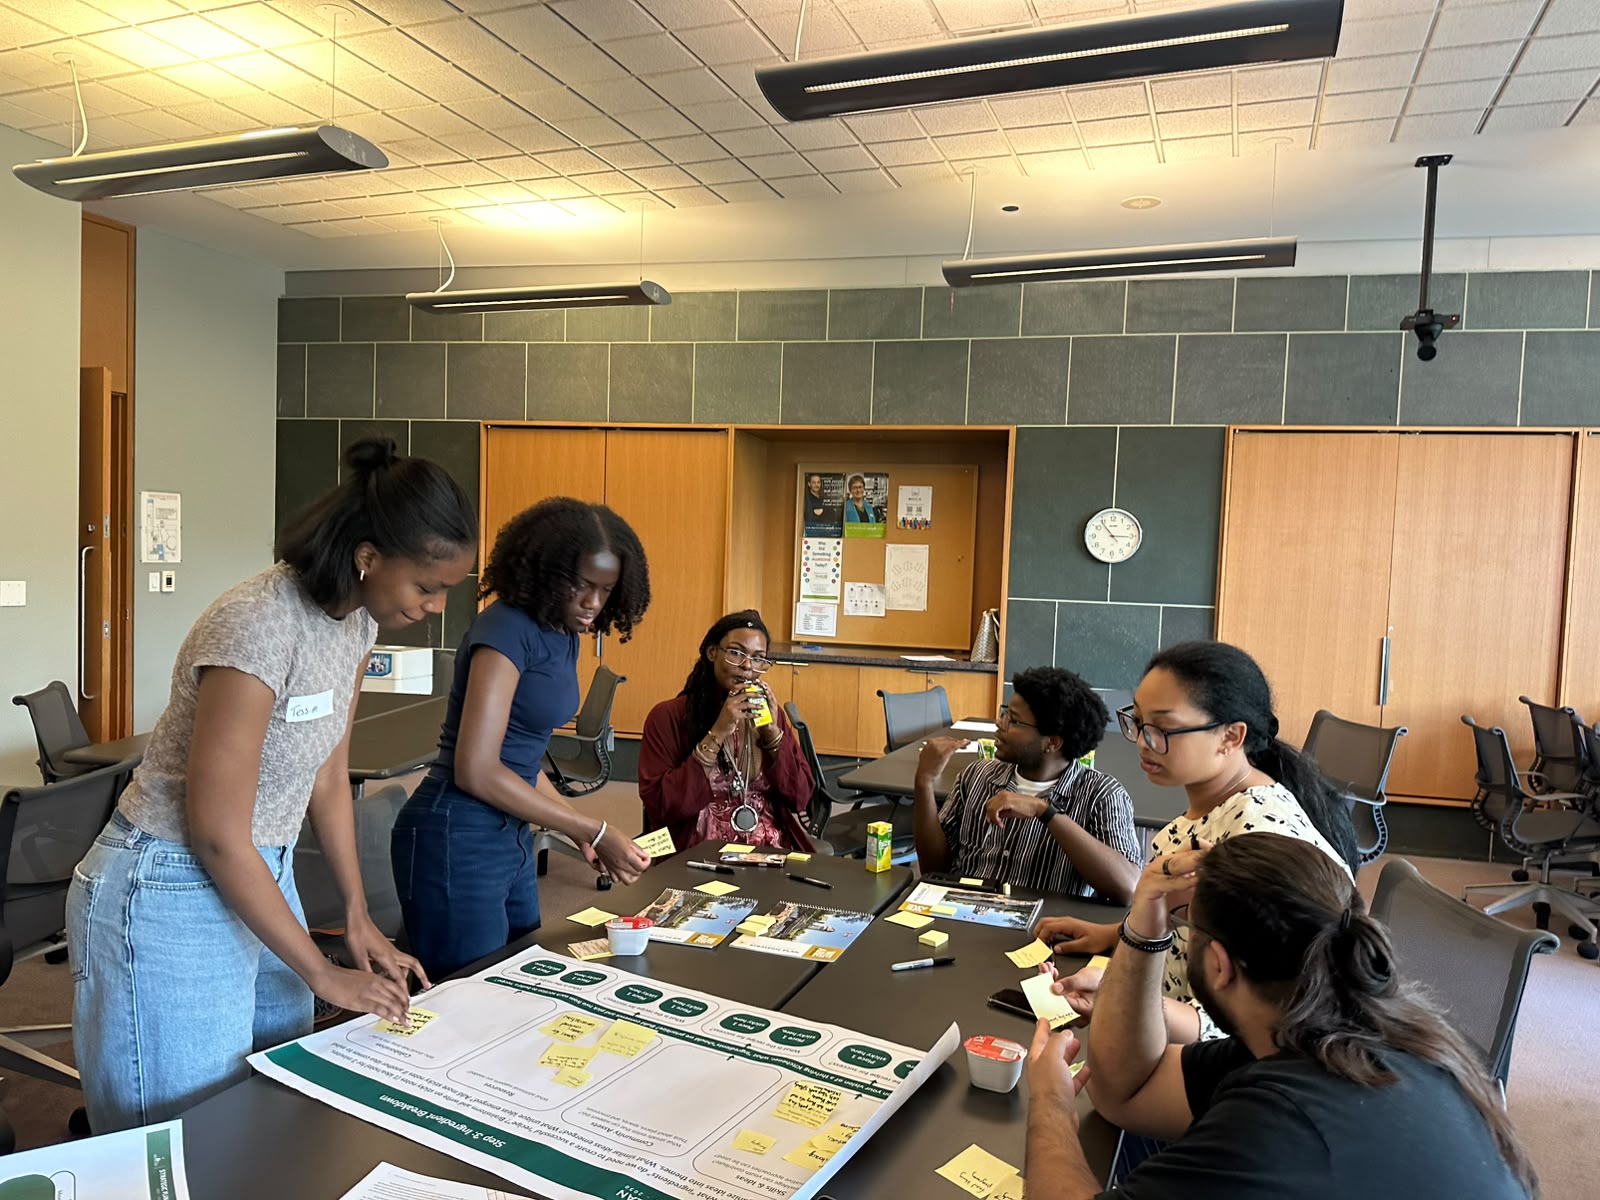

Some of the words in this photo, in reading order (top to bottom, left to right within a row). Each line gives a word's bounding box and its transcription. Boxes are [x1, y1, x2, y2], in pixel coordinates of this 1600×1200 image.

[750, 944, 781, 952] STRATEGIC
[640, 990, 658, 998] sticky
[568, 996, 581, 1004] from
[603, 996, 627, 1008] success?
[581, 1001, 593, 1010] two
[593, 1006, 604, 1015] pick
[635, 1005, 653, 1014] recipe
[685, 1002, 704, 1011] sticky
[668, 1016, 685, 1024] What
[732, 1016, 748, 1024] here.
[747, 1019, 766, 1028] sticky
[640, 1021, 656, 1030] Build
[655, 1025, 686, 1037] prioritize?
[709, 1027, 736, 1038] success?
[781, 1028, 797, 1037] here.
[797, 1031, 816, 1040] sticky
[695, 1036, 715, 1047] should
[746, 1037, 765, 1047] recipe
[376, 1043, 411, 1058] Collaboration
[850, 1047, 867, 1057] here.
[858, 1056, 876, 1065] Place
[867, 1051, 887, 1062] sticky
[381, 1063, 404, 1072] another
[828, 1061, 858, 1072] success?
[406, 1072, 424, 1081] notes
[802, 1066, 830, 1079] thriving
[870, 1072, 892, 1082] recipe
[400, 1078, 417, 1086] notes
[425, 1078, 442, 1089] sticky
[844, 1080, 864, 1089] vision
[418, 1084, 434, 1095] sticky
[442, 1085, 458, 1094] more
[484, 1083, 515, 1097] Resources
[442, 1095, 458, 1104] write
[458, 1092, 471, 1101] Add
[379, 1094, 428, 1117] Breakdown
[459, 1102, 471, 1110] and
[470, 1098, 501, 1111] emerged?
[472, 1106, 506, 1122] Brainstorm
[501, 1107, 518, 1118] ideas
[426, 1114, 472, 1135] Ingredient
[518, 1113, 540, 1126] unique
[590, 1115, 609, 1125] support
[504, 1117, 532, 1133] "recipe"?
[540, 1122, 559, 1132] What
[590, 1122, 612, 1133] Assets
[472, 1130, 483, 1139] 3:
[533, 1129, 569, 1145] successful
[559, 1129, 593, 1144] emerged?
[612, 1130, 655, 1147] Community
[646, 1134, 666, 1144] already
[659, 1130, 673, 1138] about
[674, 1134, 688, 1144] Think
[484, 1134, 506, 1148] Step
[666, 1140, 681, 1148] What
[574, 1144, 597, 1156] create
[594, 1142, 612, 1153] ideas
[612, 1149, 636, 1160] similar
[714, 1154, 731, 1163] used?
[606, 1157, 624, 1166] need
[636, 1156, 657, 1168] What
[637, 1164, 648, 1173] do
[712, 1160, 744, 1174] contribute?
[658, 1164, 688, 1182] themes.
[745, 1170, 762, 1180] youth
[752, 1166, 784, 1180] approaches
[646, 1173, 695, 1196] "ingredients"
[688, 1178, 704, 1189] into
[736, 1175, 756, 1186] Ideas
[704, 1185, 726, 1196] ideas
[765, 1185, 787, 1196] Skills
